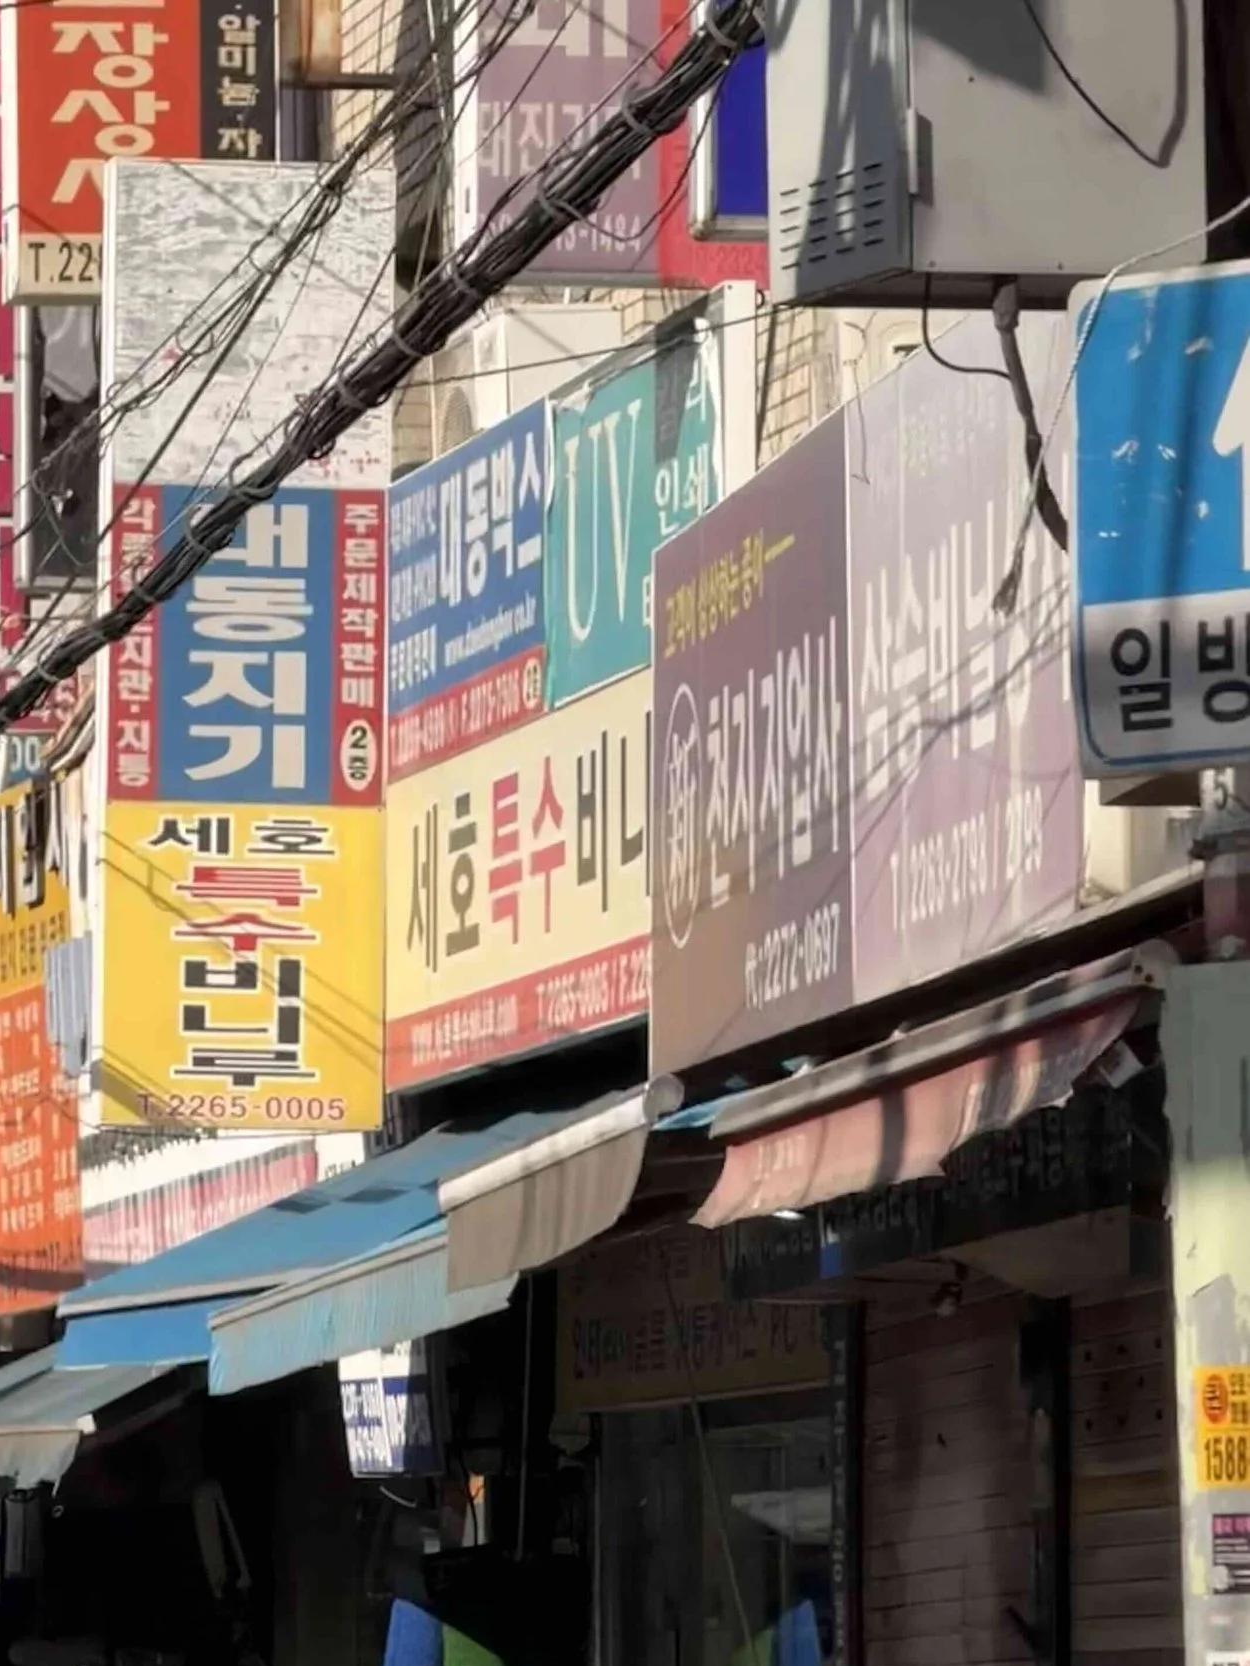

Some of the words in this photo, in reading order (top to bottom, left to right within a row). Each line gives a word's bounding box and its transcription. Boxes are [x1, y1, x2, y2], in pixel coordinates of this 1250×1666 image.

[339, 504, 380, 709] 주문제작판매
[439, 431, 542, 607] 대동박스
[564, 398, 642, 642] UV
[149, 815, 336, 856] 세호
[137, 1092, 346, 1122] T.2265-0005
